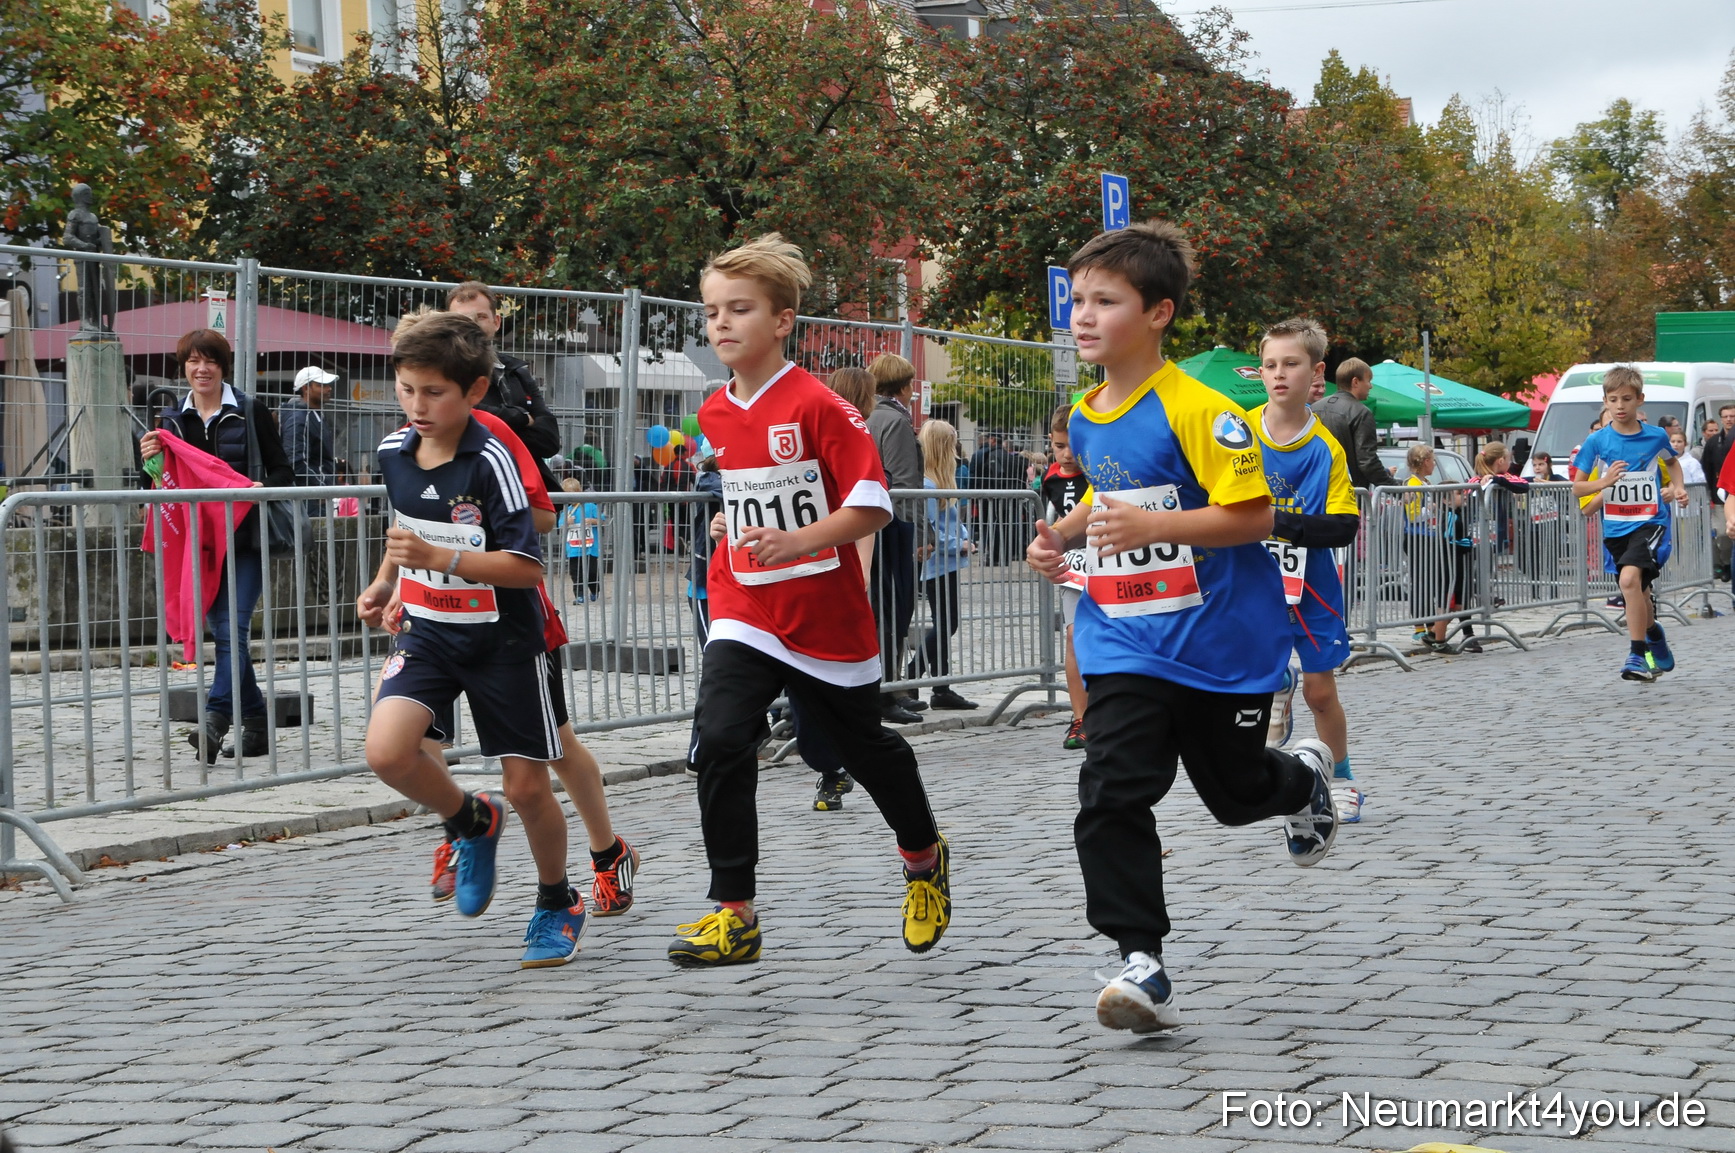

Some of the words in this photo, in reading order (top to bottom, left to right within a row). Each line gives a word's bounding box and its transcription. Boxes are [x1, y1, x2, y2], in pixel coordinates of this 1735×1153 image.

[1108, 182, 1123, 226] P
[1054, 276, 1070, 321] P
[744, 475, 800, 492] Neumarkt
[1609, 484, 1653, 502] 7010
[1063, 492, 1076, 516] 5
[728, 489, 819, 540] 7016
[419, 530, 466, 544] Neumarkt
[423, 590, 463, 609] Moritz
[1116, 580, 1154, 600] Elias
